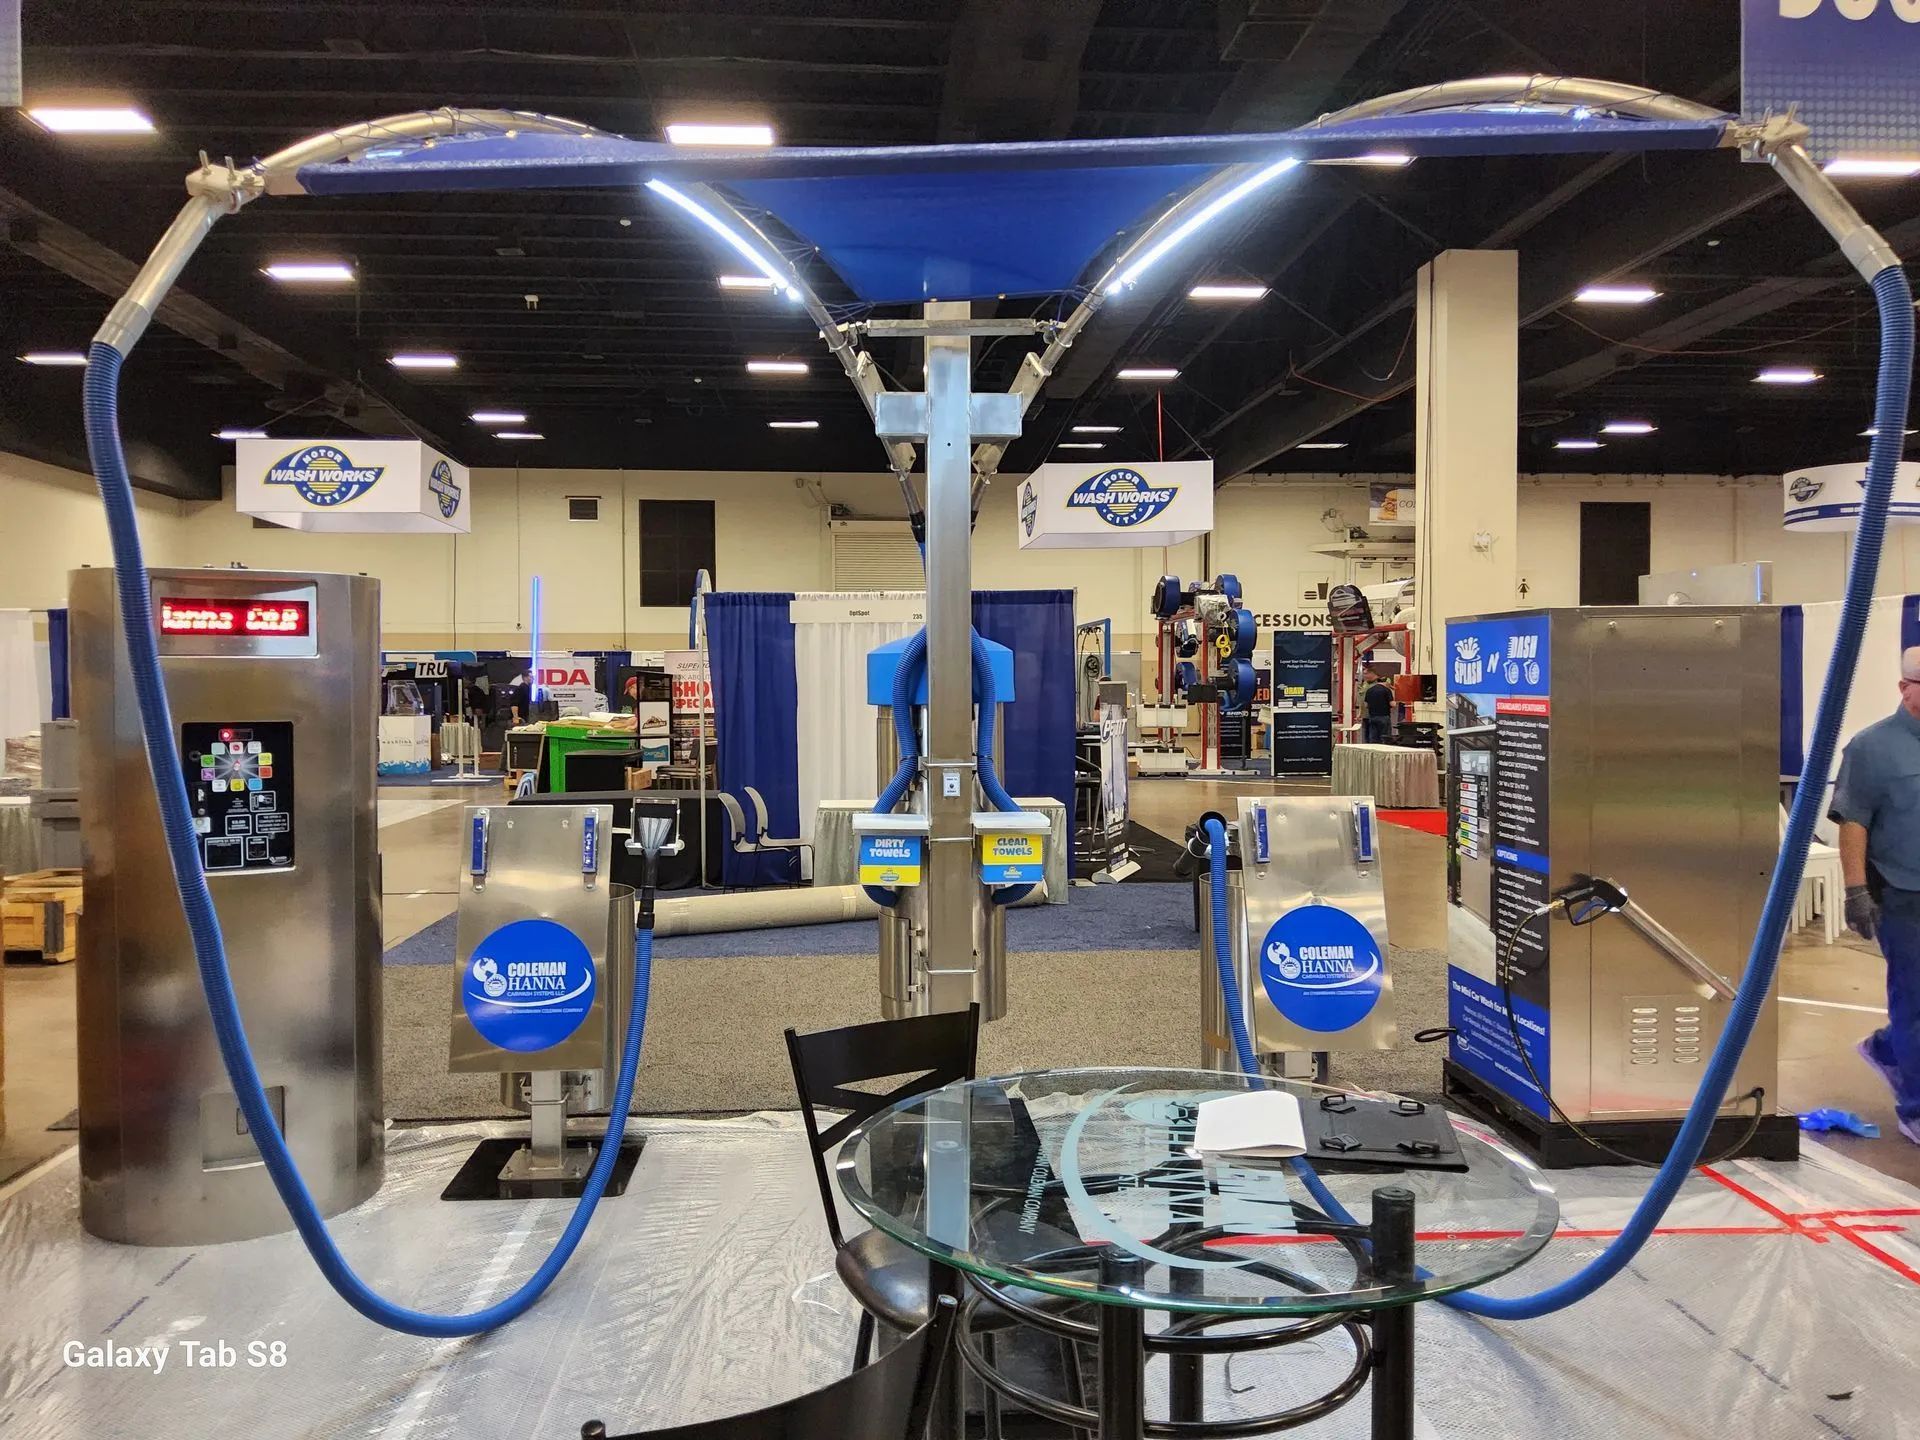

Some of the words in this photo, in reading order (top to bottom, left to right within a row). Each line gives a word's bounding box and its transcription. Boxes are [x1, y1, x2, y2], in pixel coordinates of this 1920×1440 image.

[303, 449, 343, 464] MOTOR
[271, 469, 317, 482] WASH
[318, 468, 376, 482] WORKS
[1103, 471, 1140, 487] MOTOR
[306, 491, 341, 503] CITY
[1073, 491, 1118, 504] WASH
[1118, 490, 1171, 503] WORKS
[1107, 513, 1138, 525] CITY
[1454, 660, 1482, 685] SPLASH
[1486, 652, 1500, 673] N
[1507, 635, 1538, 658] DASH
[874, 838, 905, 849] DIRTY
[1299, 946, 1354, 960] COLEMAN
[508, 961, 567, 976] COLEMAN
[1302, 960, 1355, 974] HANNA
[508, 977, 566, 991] HANNA
[1471, 990, 1480, 1002] Car
[1480, 994, 1494, 1010] Wash
[1030, 1167, 1049, 1199] COLEMAN
[1018, 1200, 1041, 1234] COMPANY
